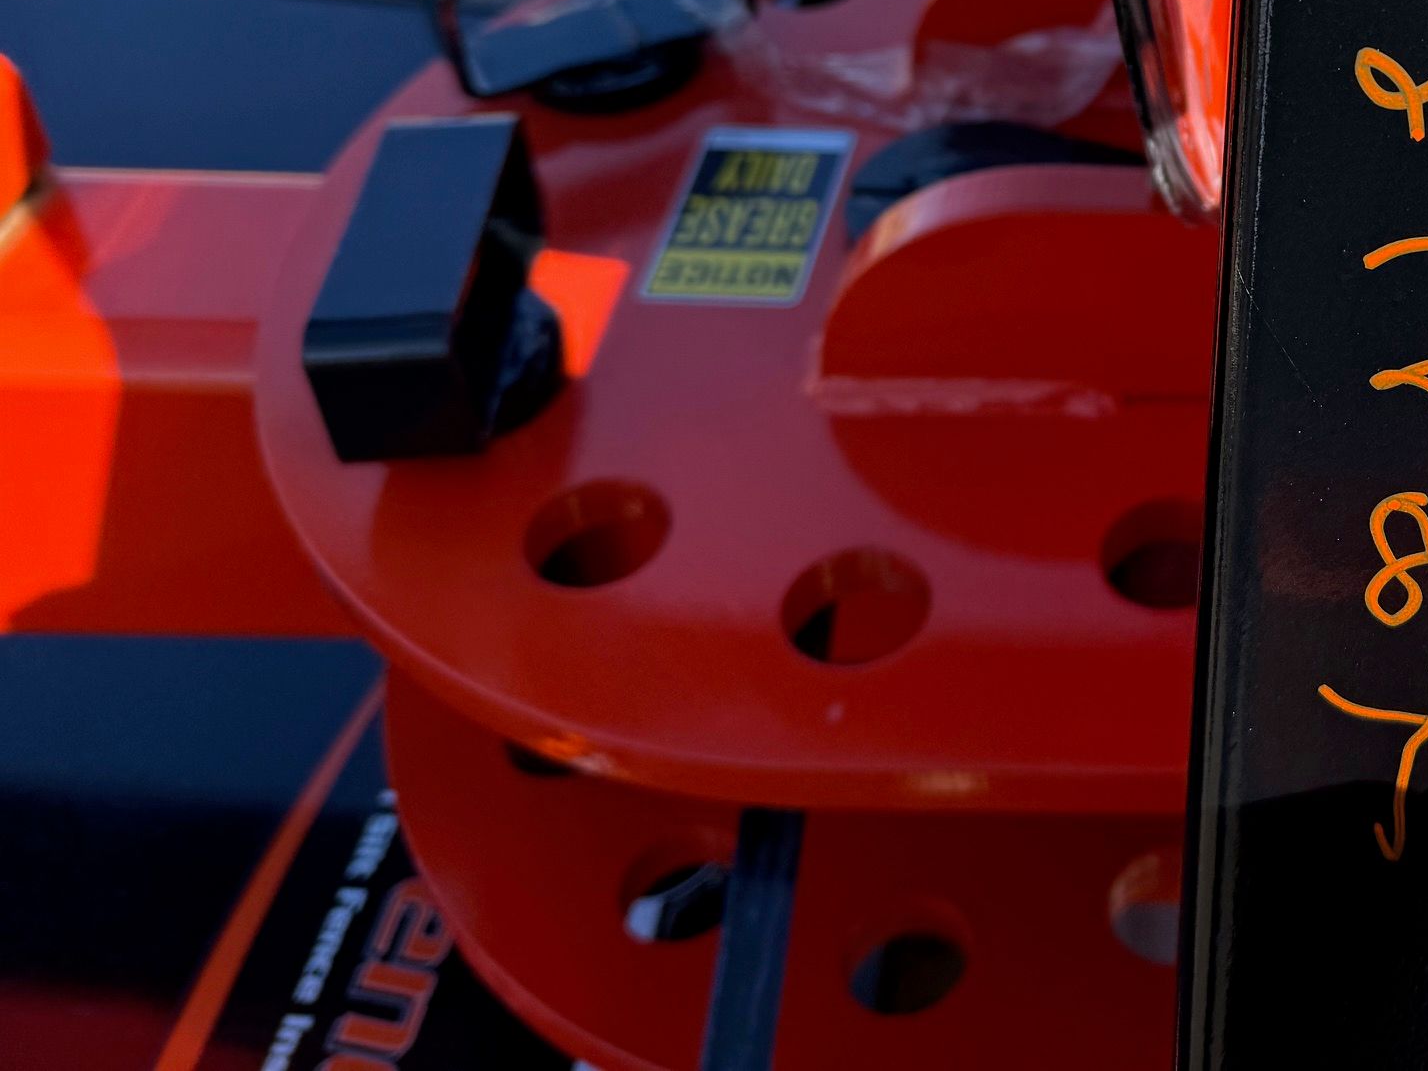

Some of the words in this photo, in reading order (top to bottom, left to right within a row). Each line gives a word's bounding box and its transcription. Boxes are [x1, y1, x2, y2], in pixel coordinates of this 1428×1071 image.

[710, 151, 819, 194] DAILY
[674, 197, 818, 246] GREASE
[658, 261, 800, 289] NOTICE
